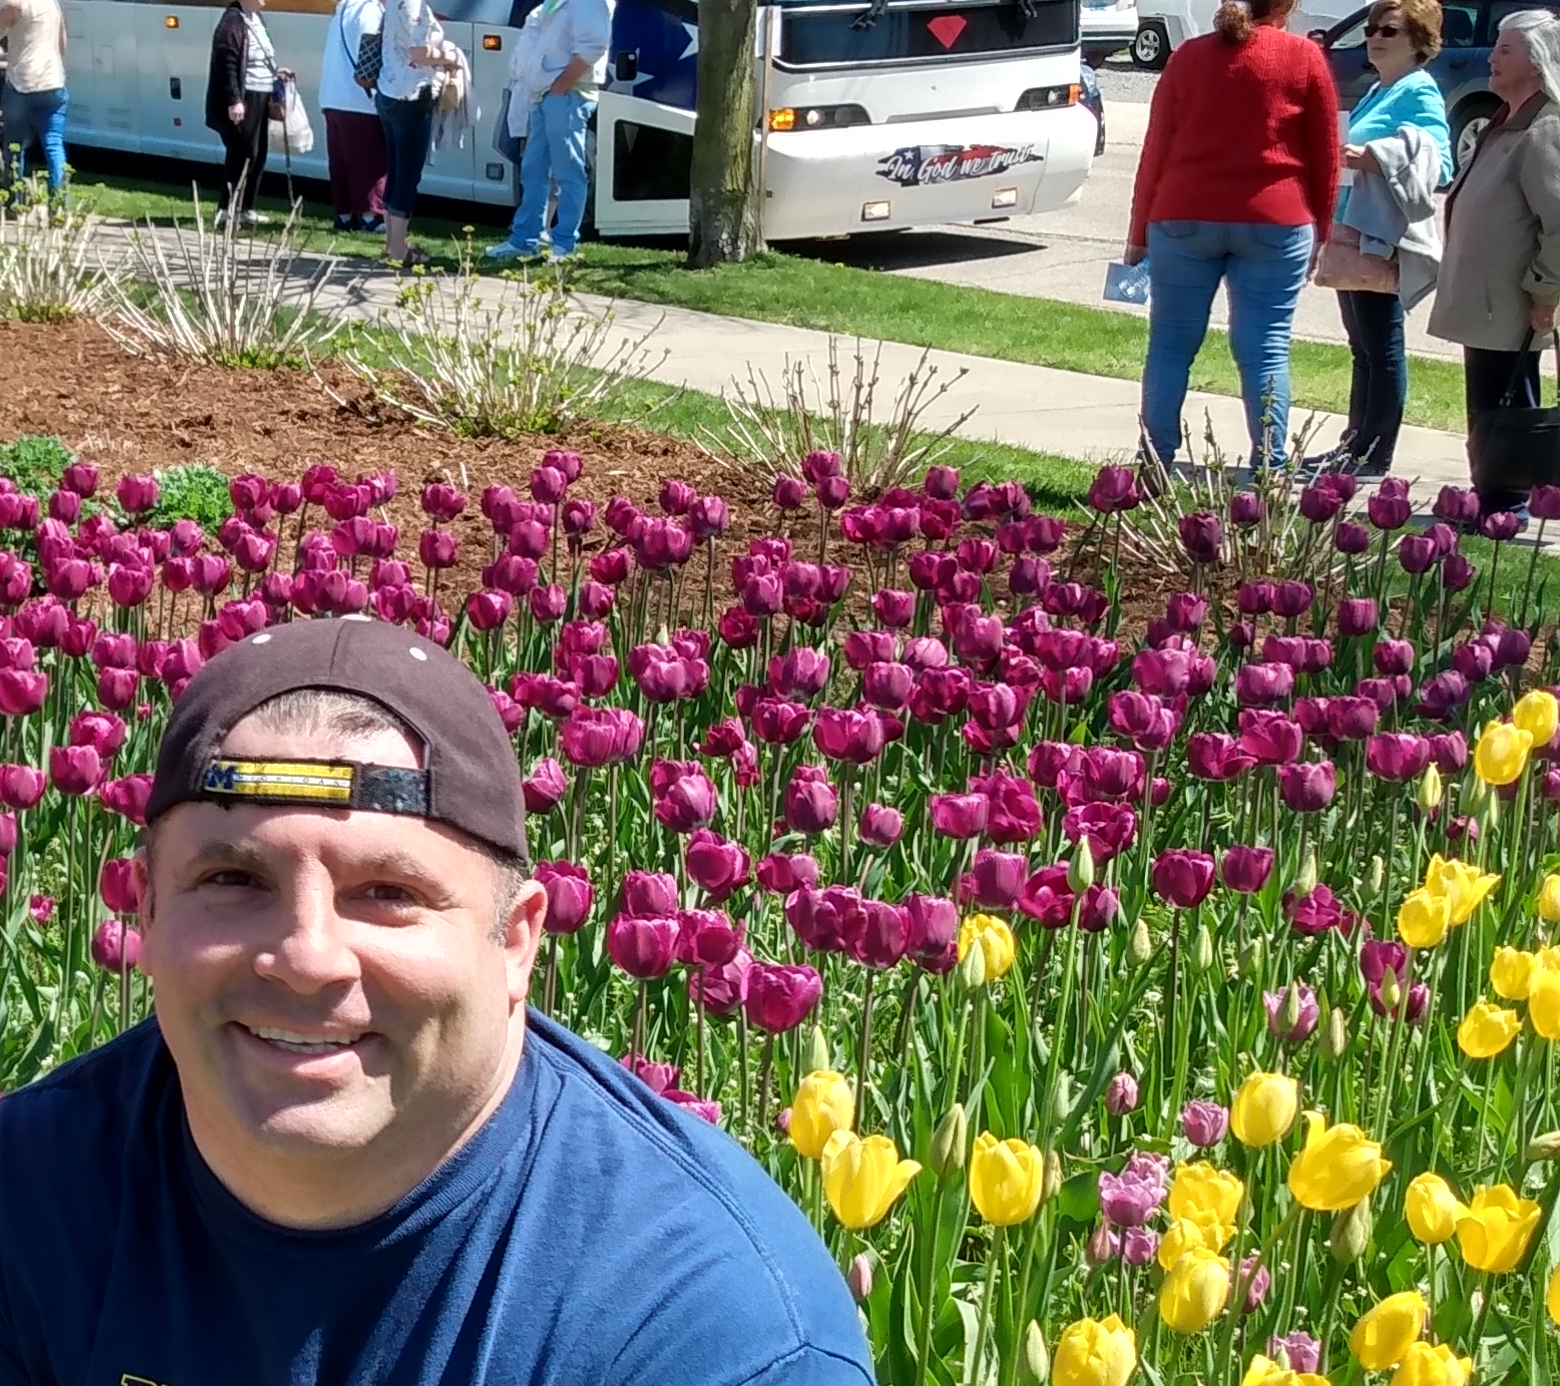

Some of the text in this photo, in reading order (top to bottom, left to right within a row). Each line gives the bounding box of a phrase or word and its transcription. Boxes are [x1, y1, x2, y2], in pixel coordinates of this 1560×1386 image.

[885, 143, 1034, 184] In God we trust
